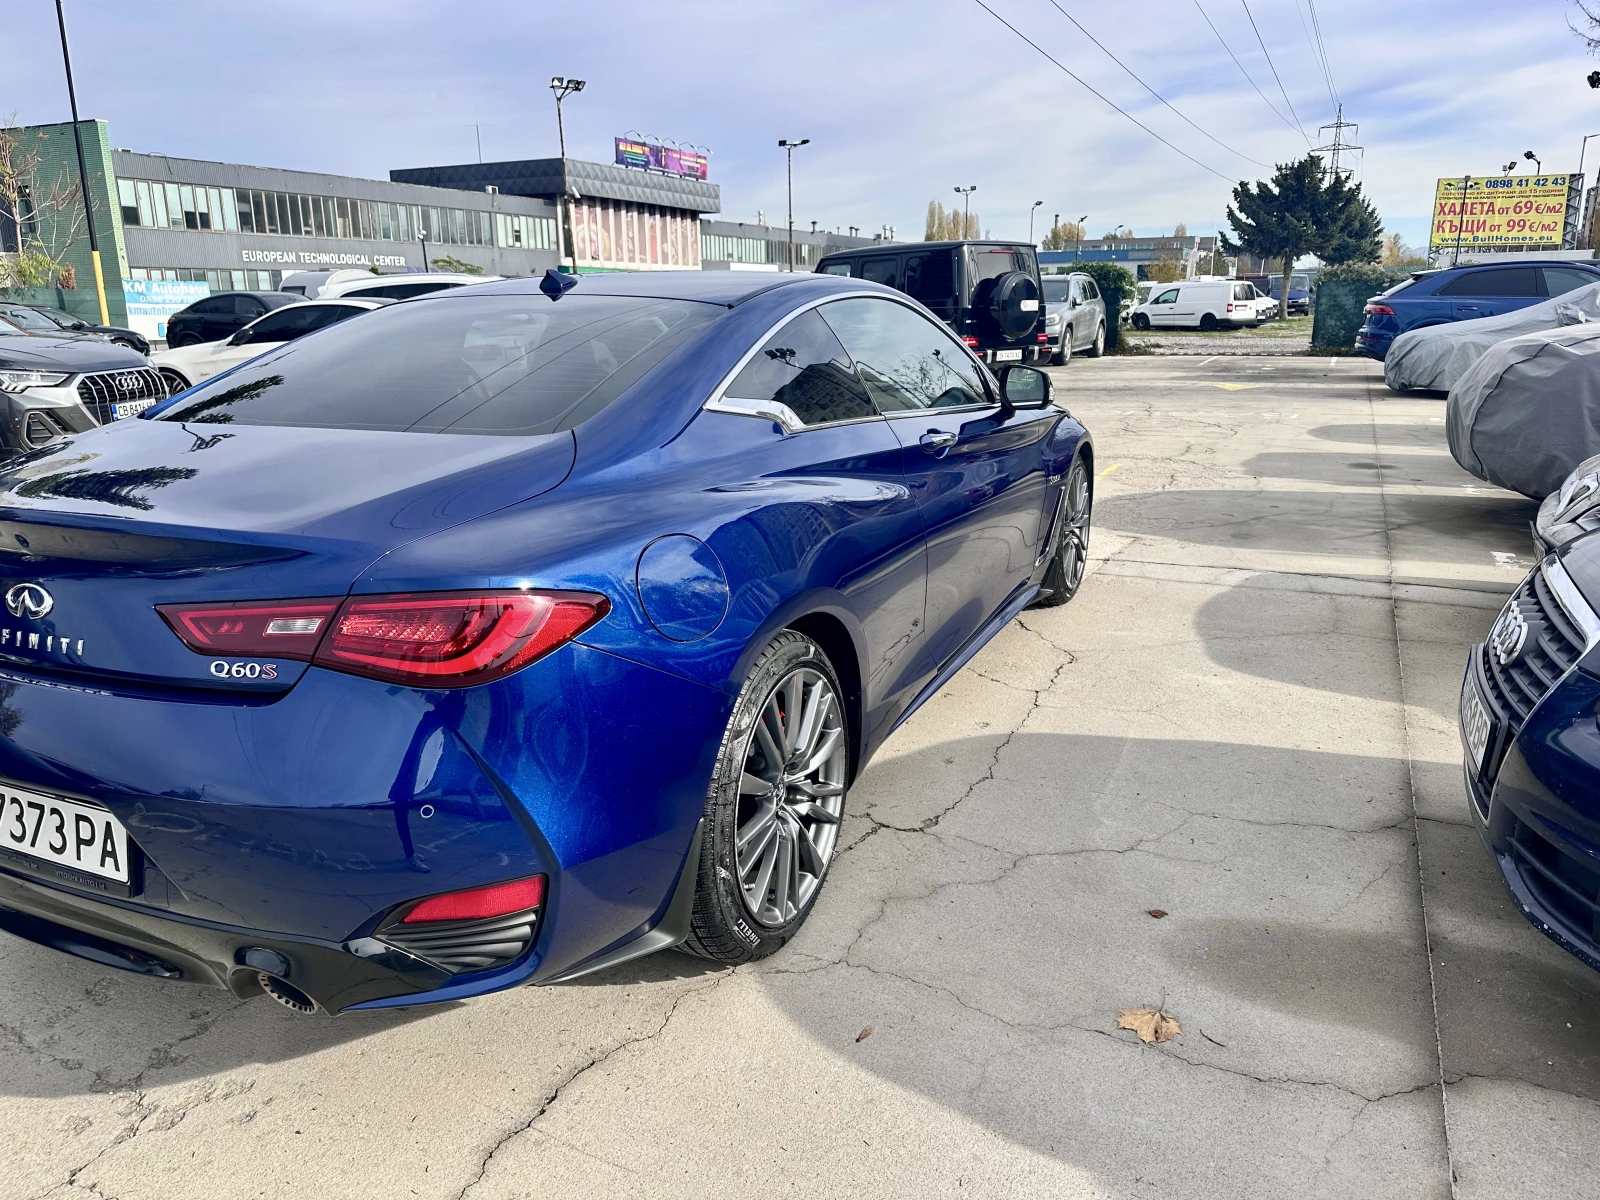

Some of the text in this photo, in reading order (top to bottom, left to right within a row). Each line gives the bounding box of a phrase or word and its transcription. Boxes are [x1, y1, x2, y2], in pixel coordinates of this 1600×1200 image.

[1485, 177, 1566, 188] 0898 41 42 43
[1437, 201, 1496, 216] ХАЛЕТА
[1497, 207, 1511, 215] от
[1436, 219, 1487, 235] КЪЩИ
[1489, 224, 1502, 232] от
[242, 250, 406, 267] EUROPEAN TECHNOLOGICAL CENTER
[124, 281, 208, 294] KM Autohaus
[210, 660, 278, 680] Q60S
